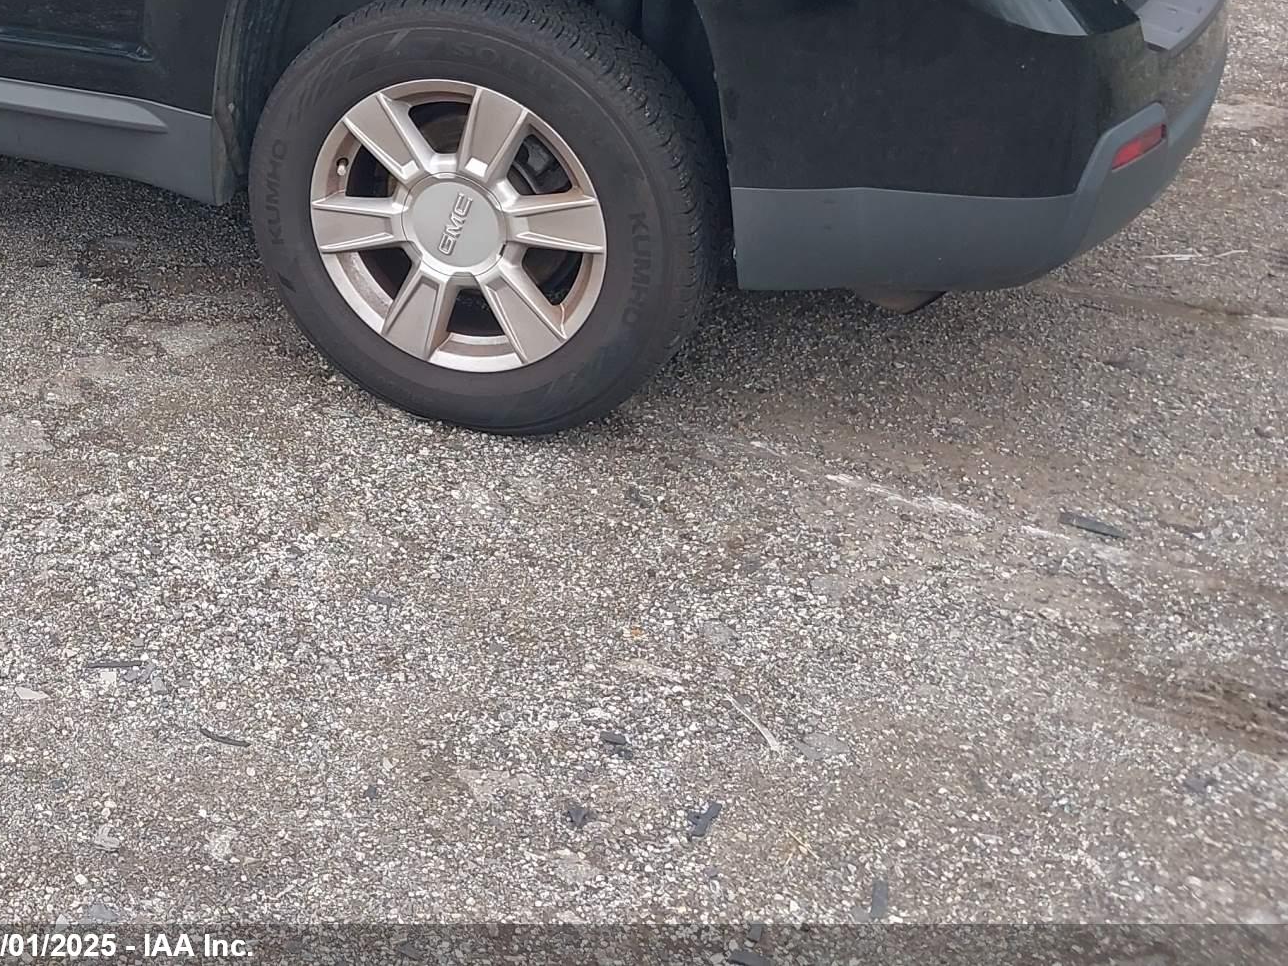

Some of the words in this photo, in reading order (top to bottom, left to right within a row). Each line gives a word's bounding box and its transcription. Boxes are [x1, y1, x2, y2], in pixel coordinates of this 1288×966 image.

[265, 138, 289, 244] KUMHO
[438, 192, 474, 256] GMC
[621, 210, 651, 323] KUMHO
